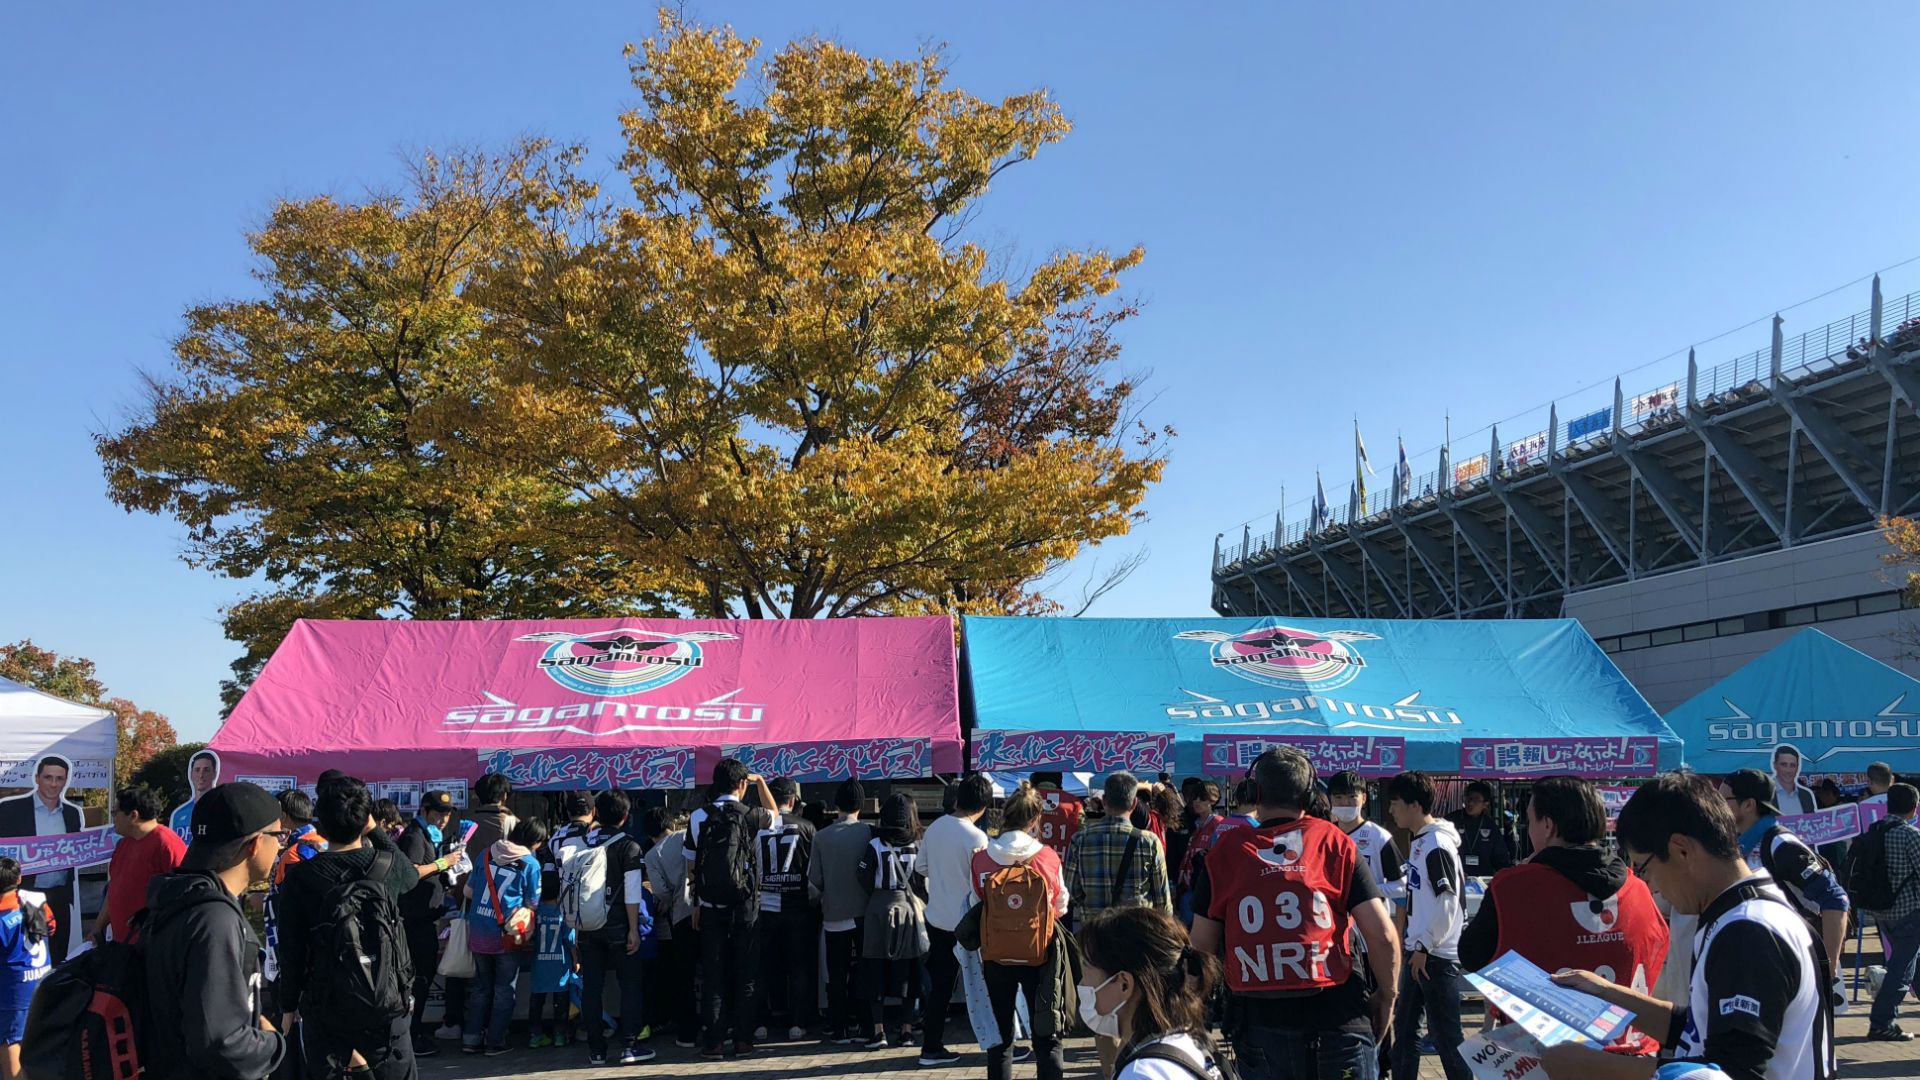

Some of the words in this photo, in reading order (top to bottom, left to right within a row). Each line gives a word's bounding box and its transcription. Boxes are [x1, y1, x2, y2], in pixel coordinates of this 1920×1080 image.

[197, 824, 208, 836] H
[767, 834, 800, 874] 17
[539, 924, 561, 953] 17
